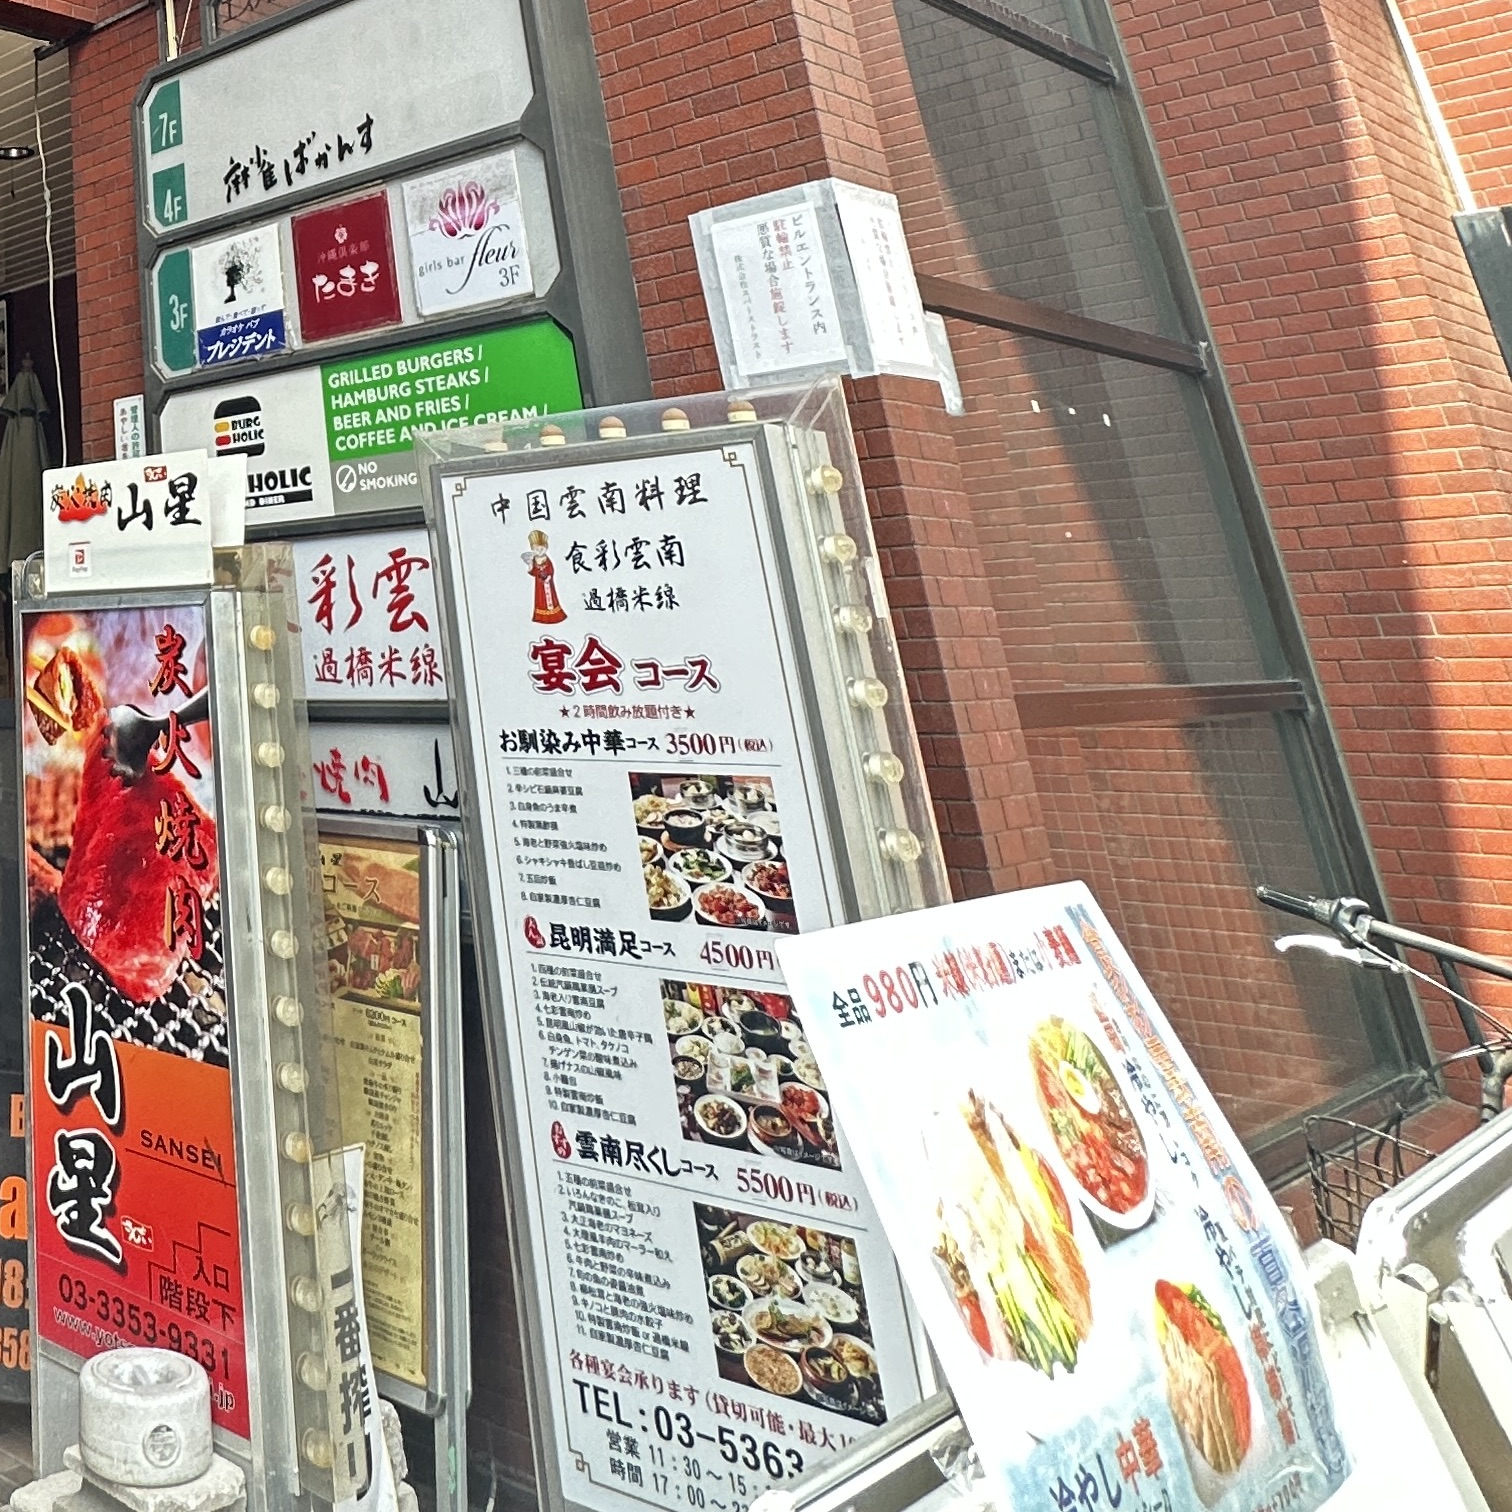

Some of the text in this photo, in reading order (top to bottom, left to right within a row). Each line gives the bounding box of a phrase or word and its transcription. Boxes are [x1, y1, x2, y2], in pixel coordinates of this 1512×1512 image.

[159, 112, 179, 147] 7F
[163, 188, 183, 220] 4F
[312, 260, 380, 303] たまき
[418, 256, 465, 277] girls bar
[499, 264, 521, 288] 3F
[169, 294, 187, 331] 3F
[328, 363, 393, 389] GRILLED
[396, 347, 474, 376] BURGERS
[331, 381, 411, 410] HAMBURG
[415, 368, 481, 395] STEAKS
[231, 415, 261, 431] BURG
[333, 410, 372, 431] BEER
[375, 404, 411, 425] AND
[415, 395, 461, 417] FRIES
[232, 428, 265, 445] HOLIC
[335, 428, 396, 452] COFFEE
[358, 461, 377, 475] NO
[359, 472, 419, 492] SMOKING
[117, 471, 202, 531] 山星
[490, 473, 709, 525] 中国雲南料理
[565, 534, 686, 574] 食彩雲南
[583, 583, 680, 613] 過橋米線
[313, 645, 444, 688] 過橋米線
[148, 623, 209, 962] 炭火焼肉
[549, 921, 677, 960] 昆明満足コース
[45, 982, 124, 1266] 山星
[193, 1256, 231, 1293] 入口
[159, 1274, 237, 1332] 階段下
[58, 1274, 231, 1381] 03-3353-9331
